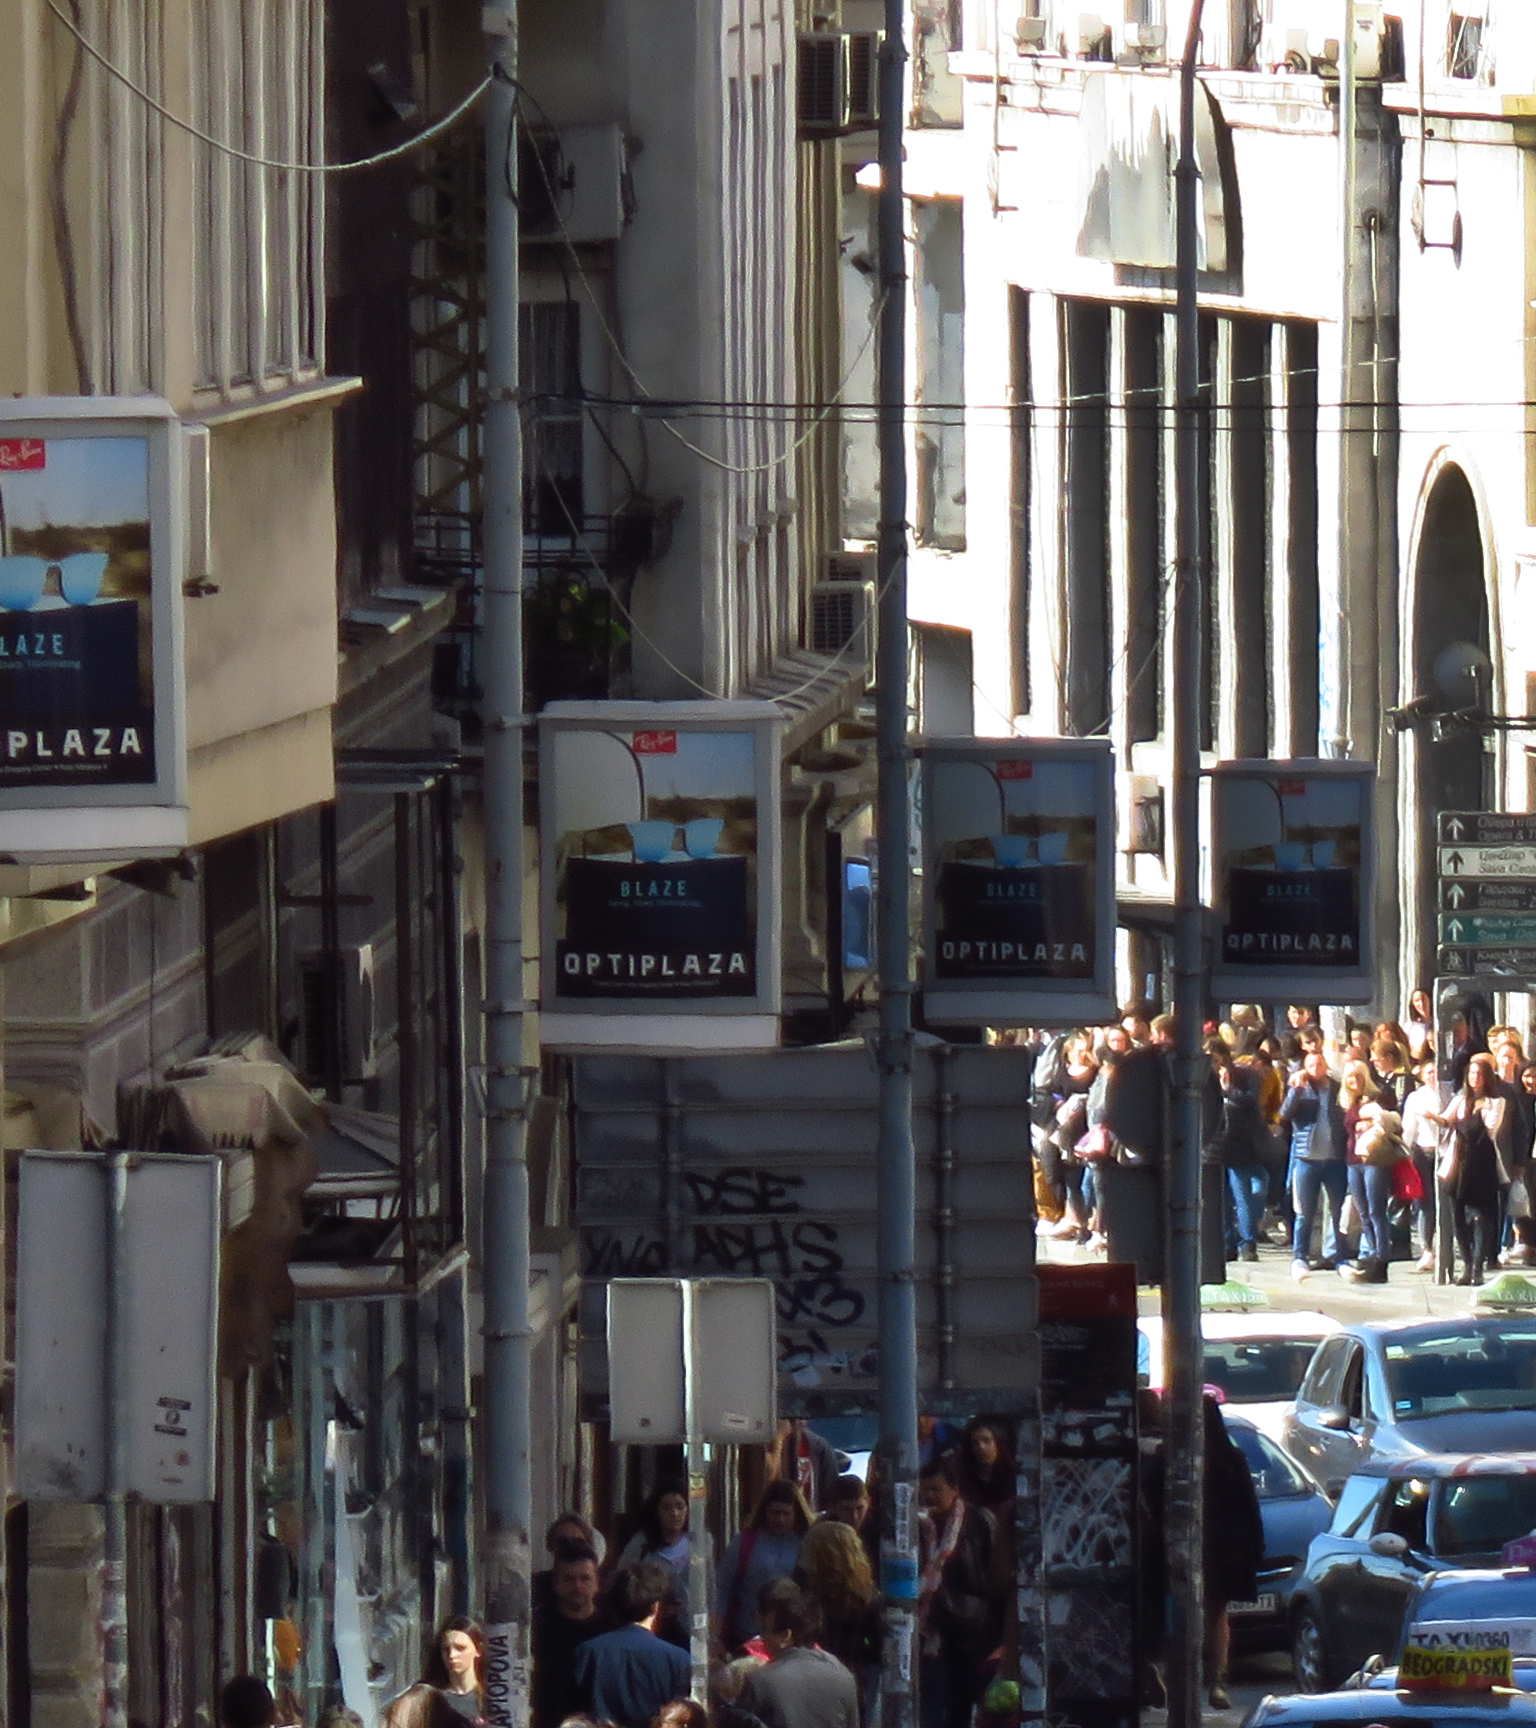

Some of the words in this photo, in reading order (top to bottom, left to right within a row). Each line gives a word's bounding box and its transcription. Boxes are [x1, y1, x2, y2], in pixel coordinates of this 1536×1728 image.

[620, 880, 688, 898] BLAZE
[985, 882, 1038, 898] BLAZE
[941, 940, 1087, 962] OPTIPLAZA
[1225, 931, 1354, 951] OPTIPLAZA
[564, 952, 747, 977] OPTIPLAZA
[1411, 1631, 1470, 1649] TAXI
[1402, 1651, 1508, 1677] BEOGRADSKI
